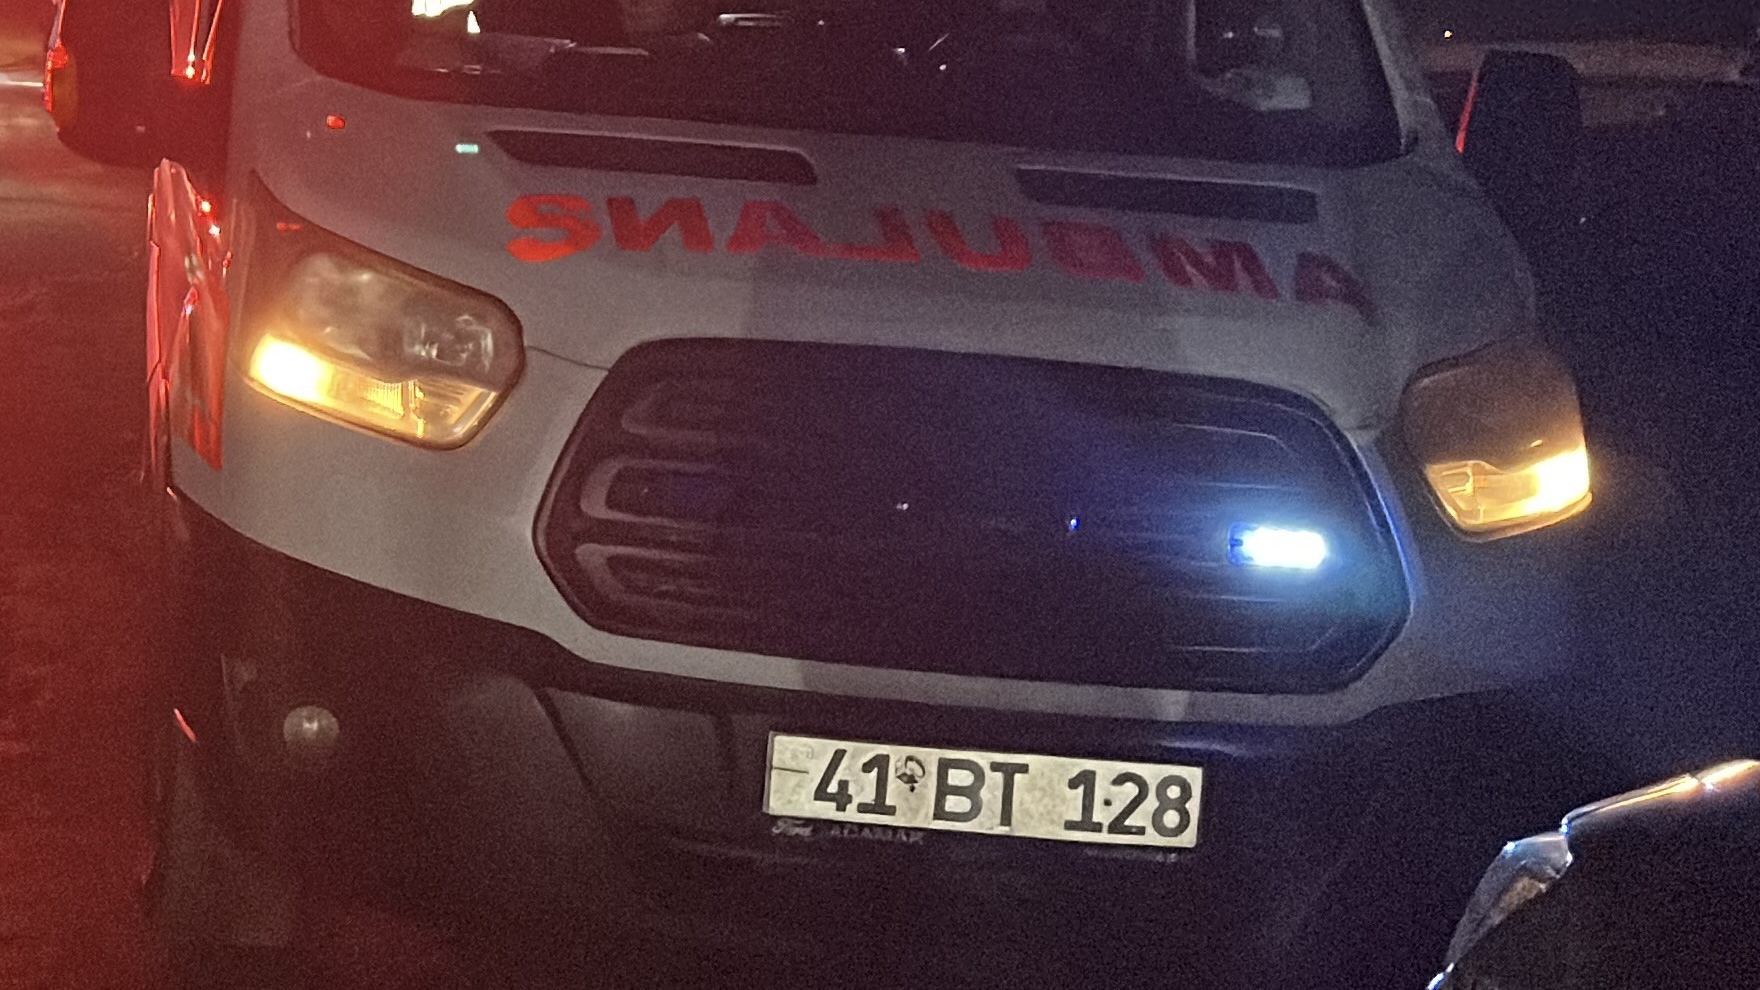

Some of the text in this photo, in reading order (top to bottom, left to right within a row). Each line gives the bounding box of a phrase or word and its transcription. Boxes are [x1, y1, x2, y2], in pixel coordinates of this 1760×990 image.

[813, 748, 1193, 839] 41 BT 128
